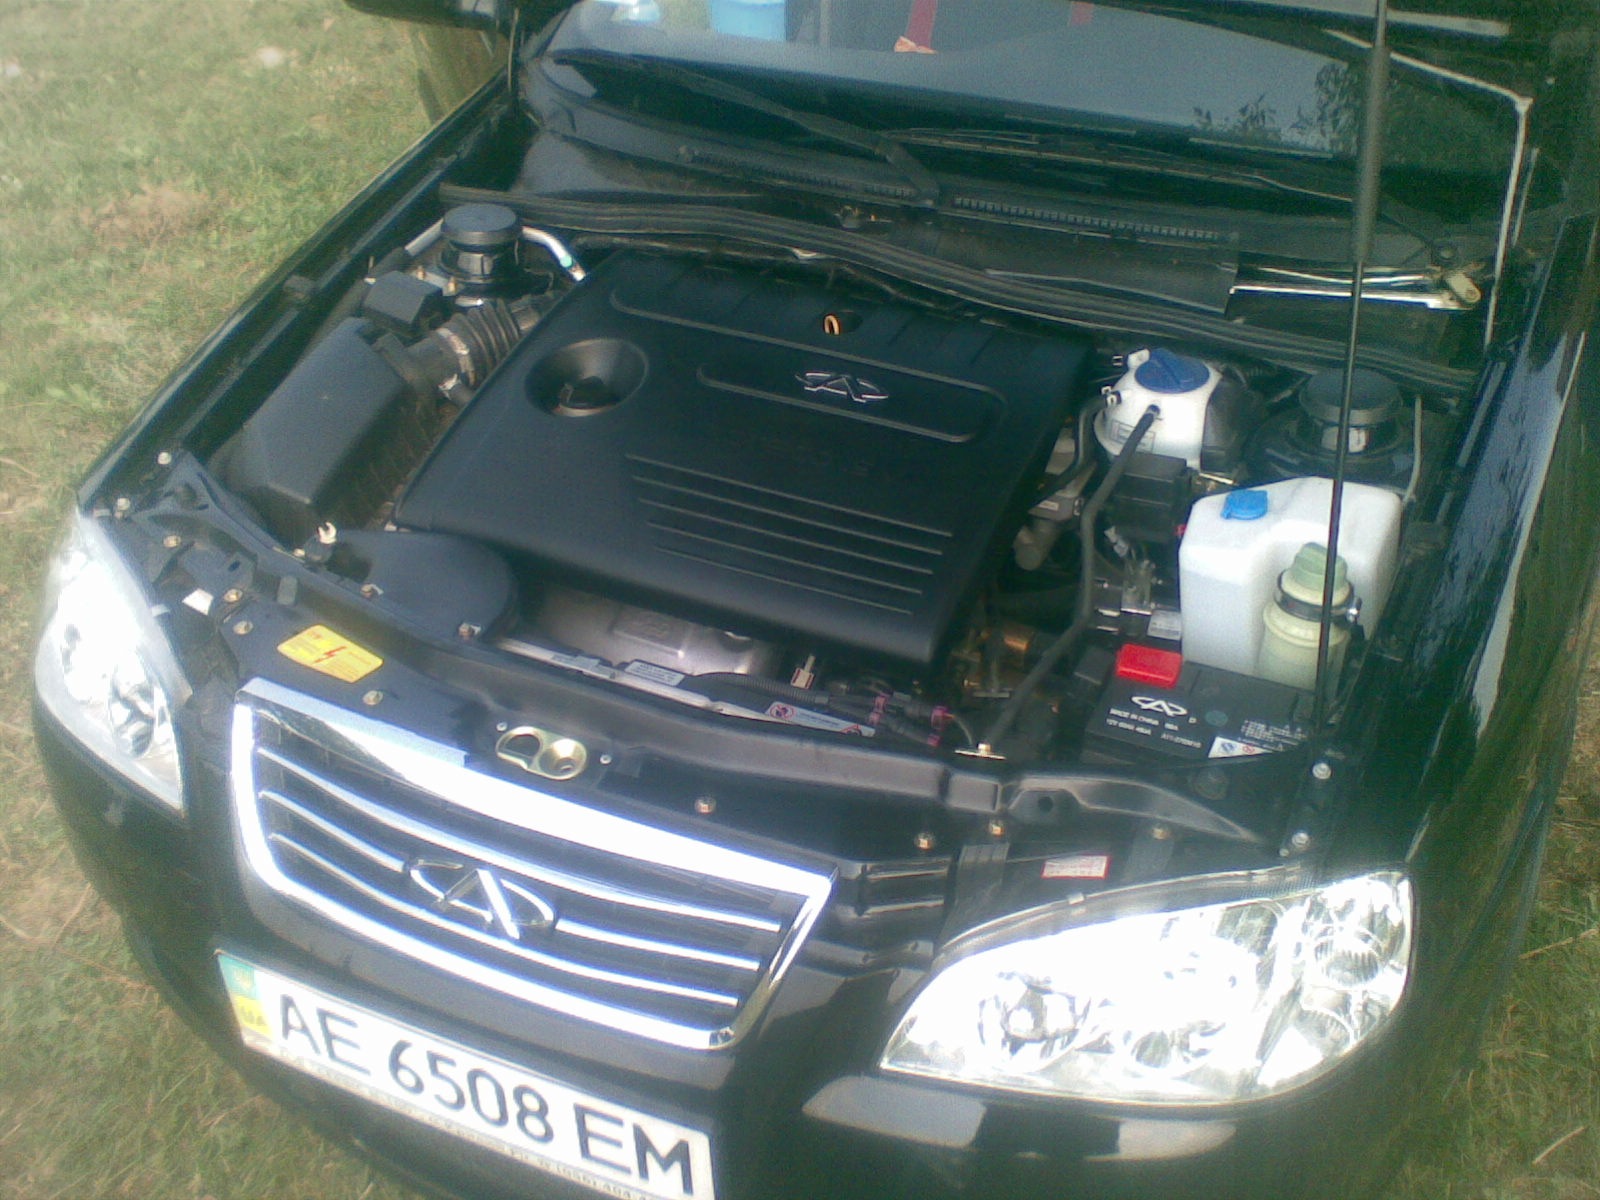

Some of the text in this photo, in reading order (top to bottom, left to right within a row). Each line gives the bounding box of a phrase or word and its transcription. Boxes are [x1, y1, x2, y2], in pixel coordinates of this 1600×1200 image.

[280, 993, 372, 1077] AE
[388, 1039, 554, 1144] 6508
[573, 1102, 694, 1197] EM
